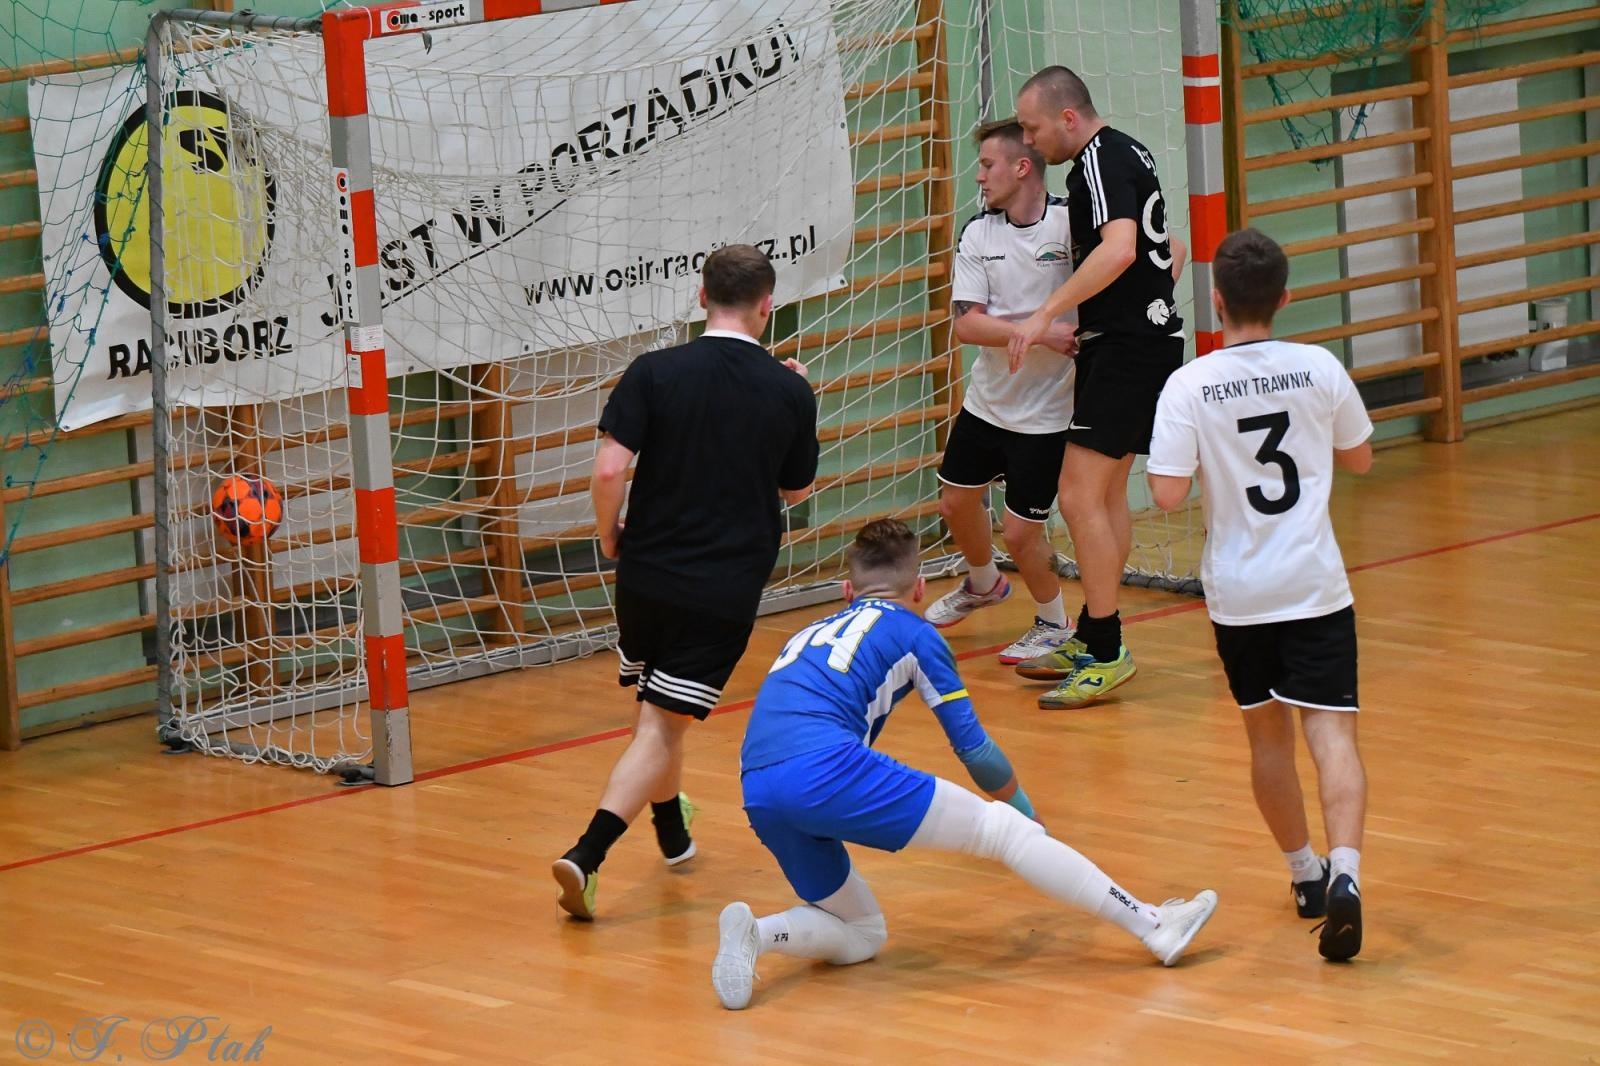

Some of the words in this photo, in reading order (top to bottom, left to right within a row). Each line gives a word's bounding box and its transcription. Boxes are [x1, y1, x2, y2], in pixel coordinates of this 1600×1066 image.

[428, 3, 465, 23] sport
[320, 217, 437, 327] JST
[1202, 379, 1248, 404] PIĘKNY
[1251, 371, 1314, 395] TRAWNIK
[1237, 411, 1301, 516] 3
